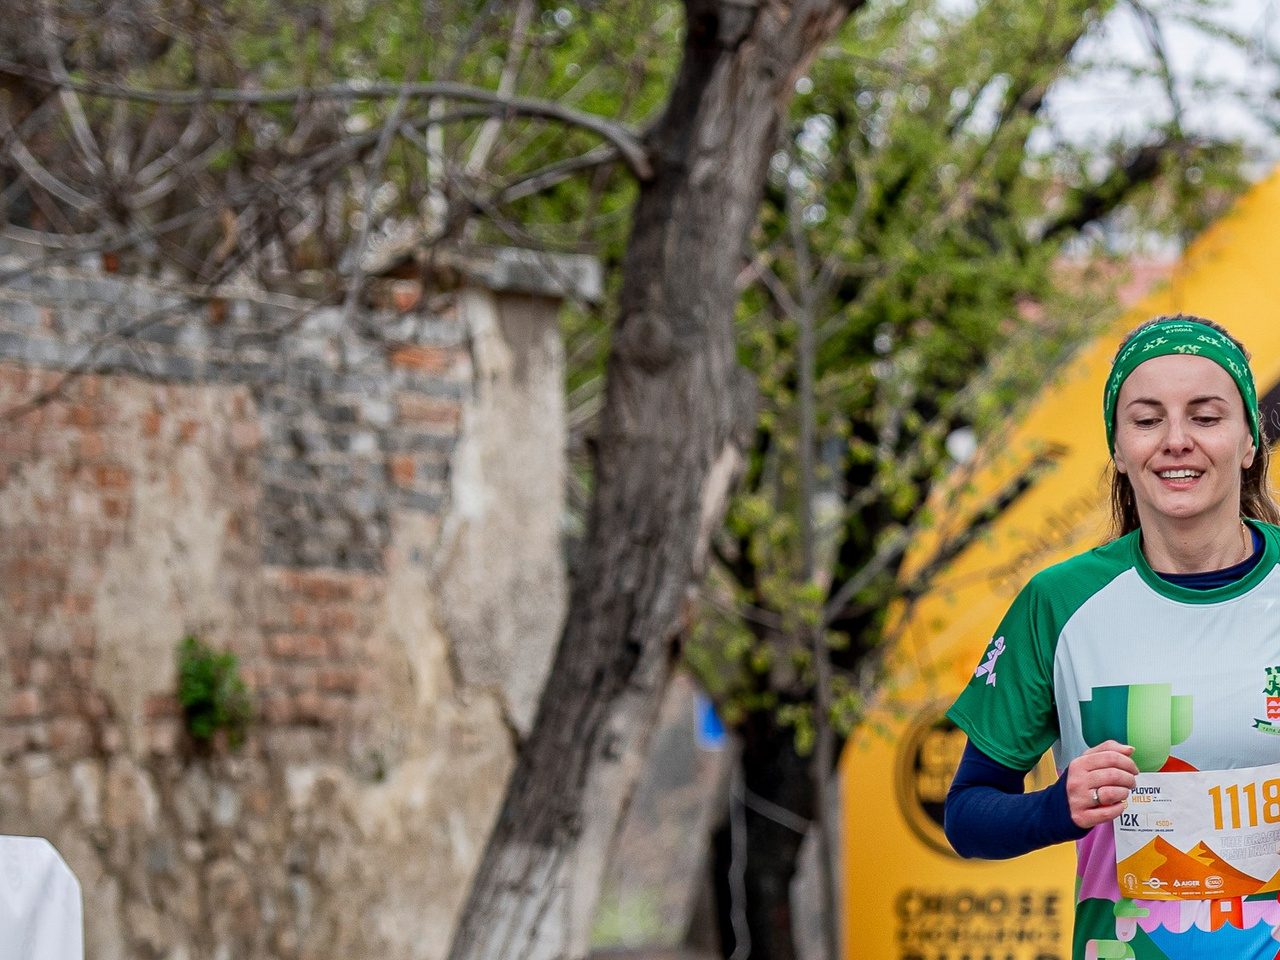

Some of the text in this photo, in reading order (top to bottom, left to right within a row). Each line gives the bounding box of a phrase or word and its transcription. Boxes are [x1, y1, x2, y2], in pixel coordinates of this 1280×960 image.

[1131, 787, 1161, 795] PLOVDIV
[1131, 795, 1152, 803] HILLS
[1119, 813, 1140, 827] 12K
[896, 887, 1062, 919] CHOOSE
